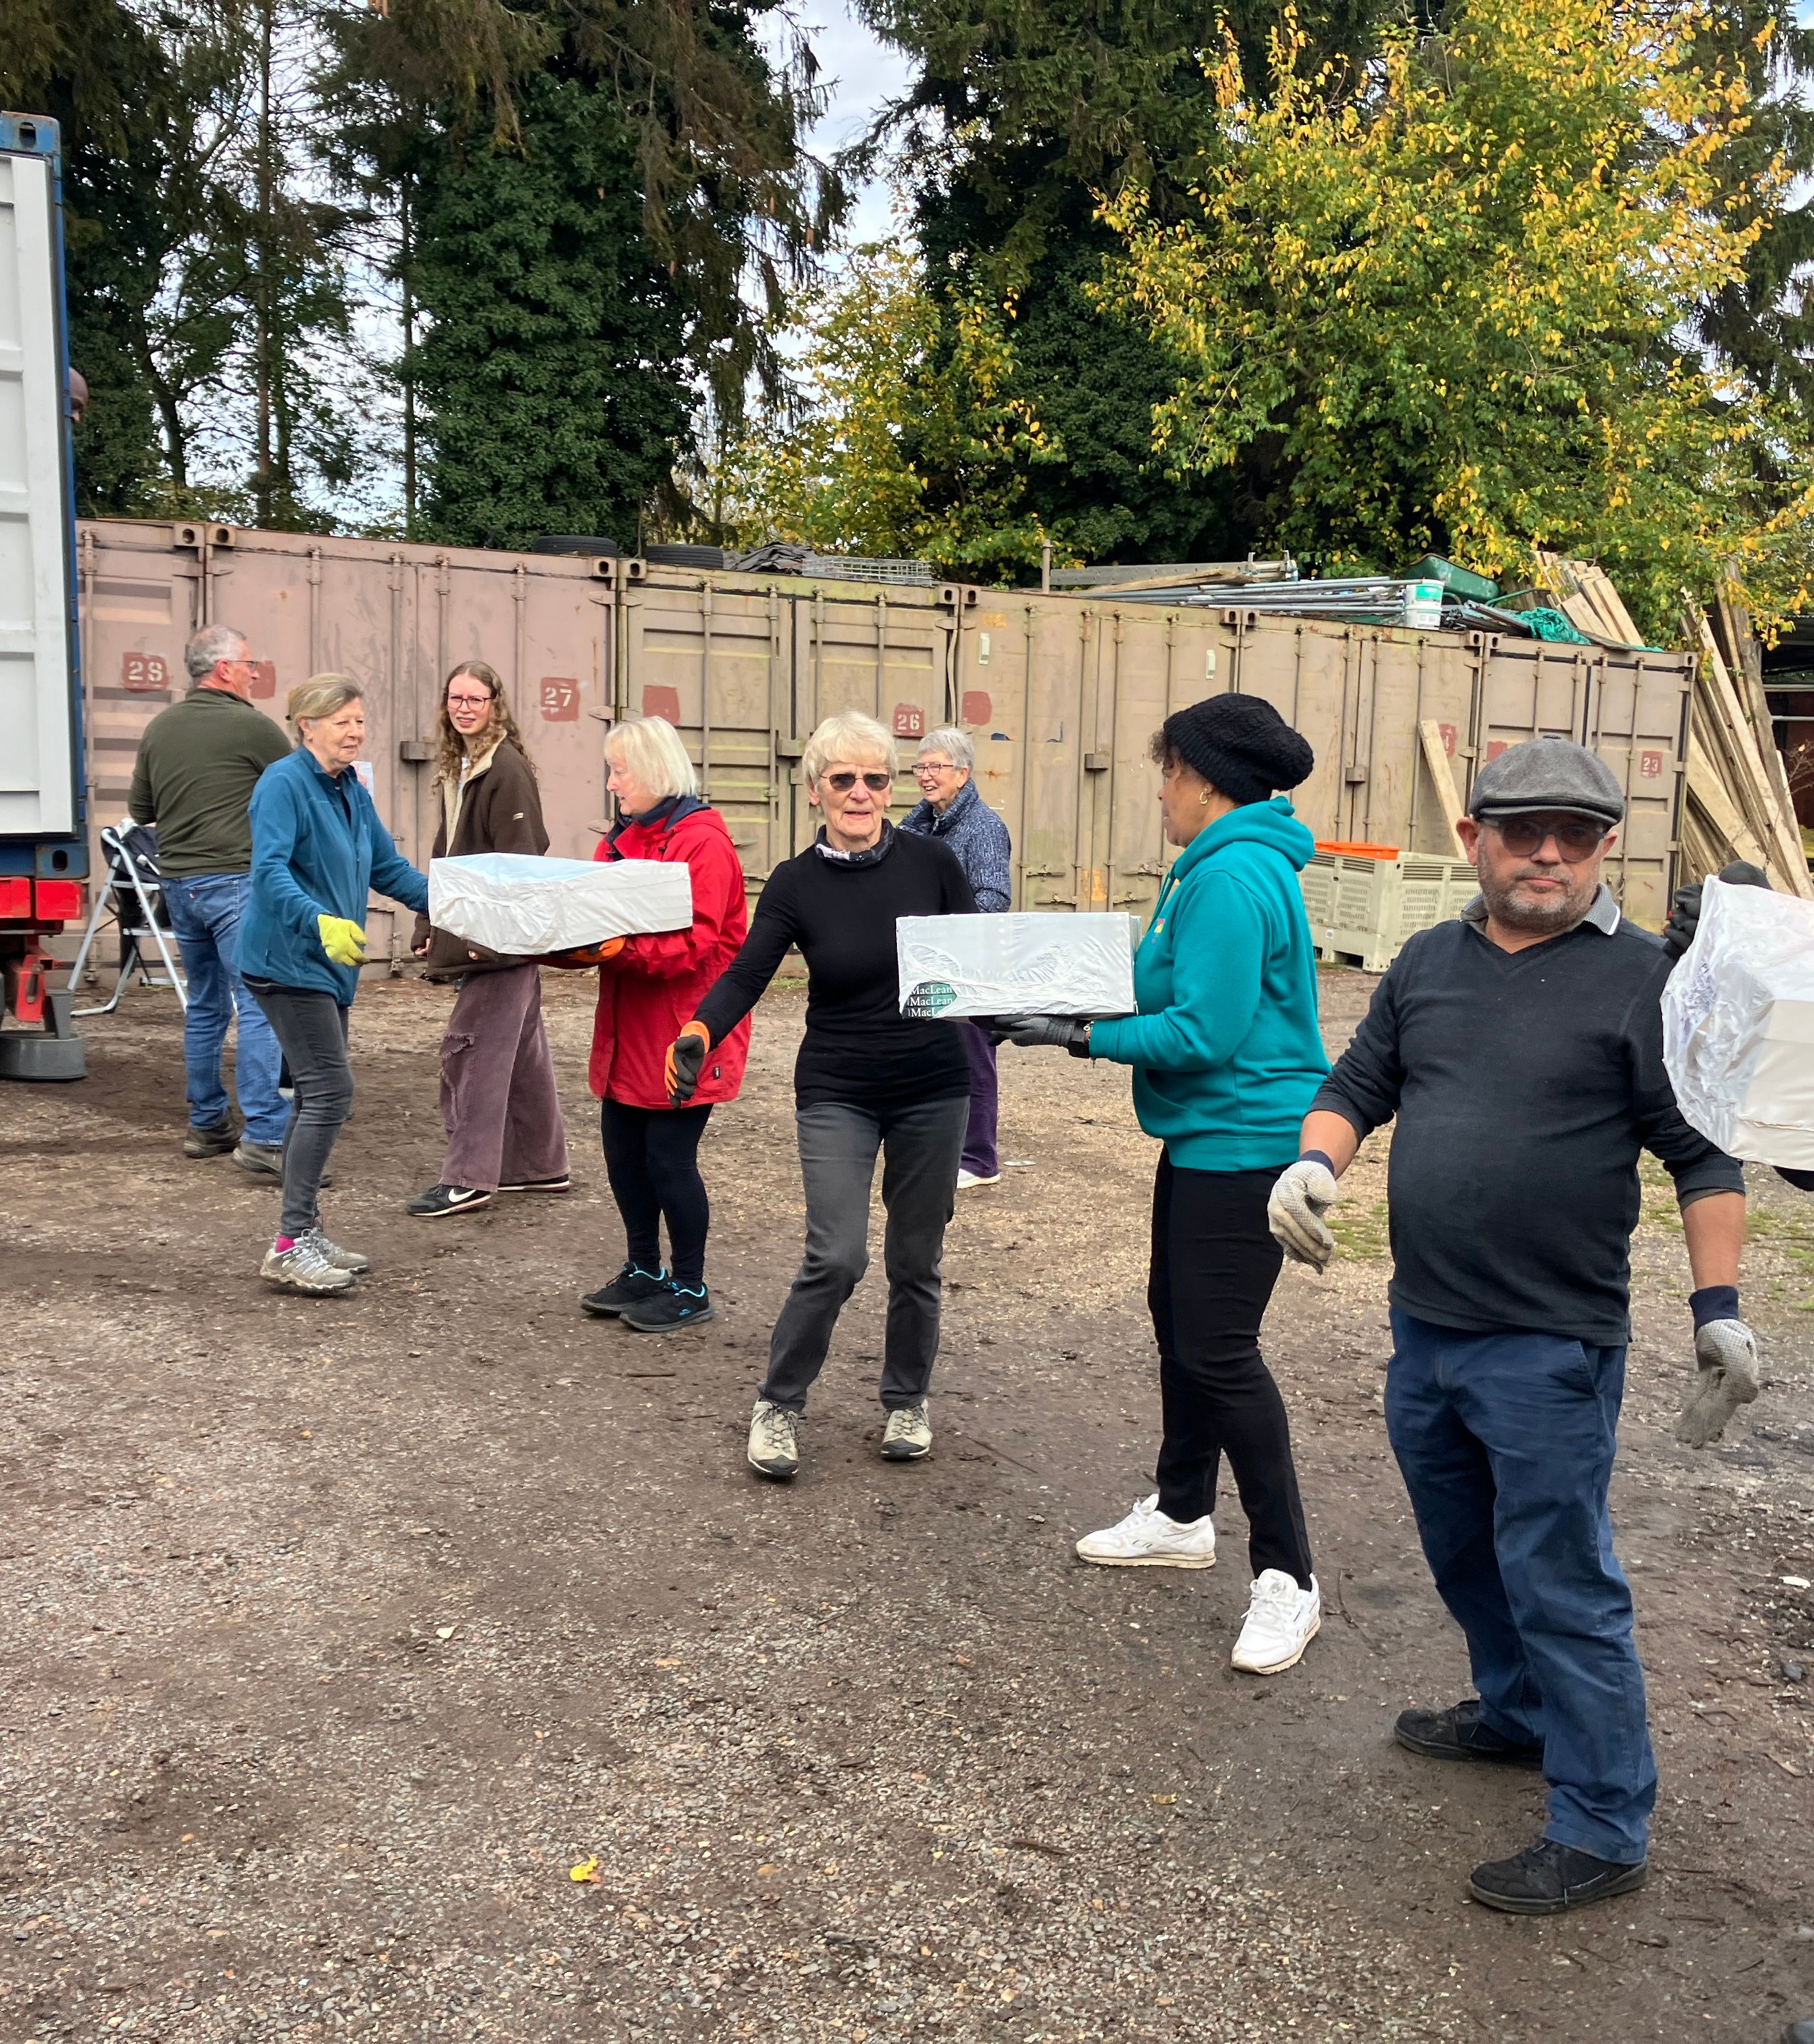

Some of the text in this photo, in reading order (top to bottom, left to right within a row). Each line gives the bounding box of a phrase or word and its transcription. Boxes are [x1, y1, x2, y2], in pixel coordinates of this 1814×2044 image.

[545, 687, 572, 707] 27
[898, 714, 920, 730] 26
[1643, 757, 1659, 772] 23
[910, 996, 953, 1006] MacLean
